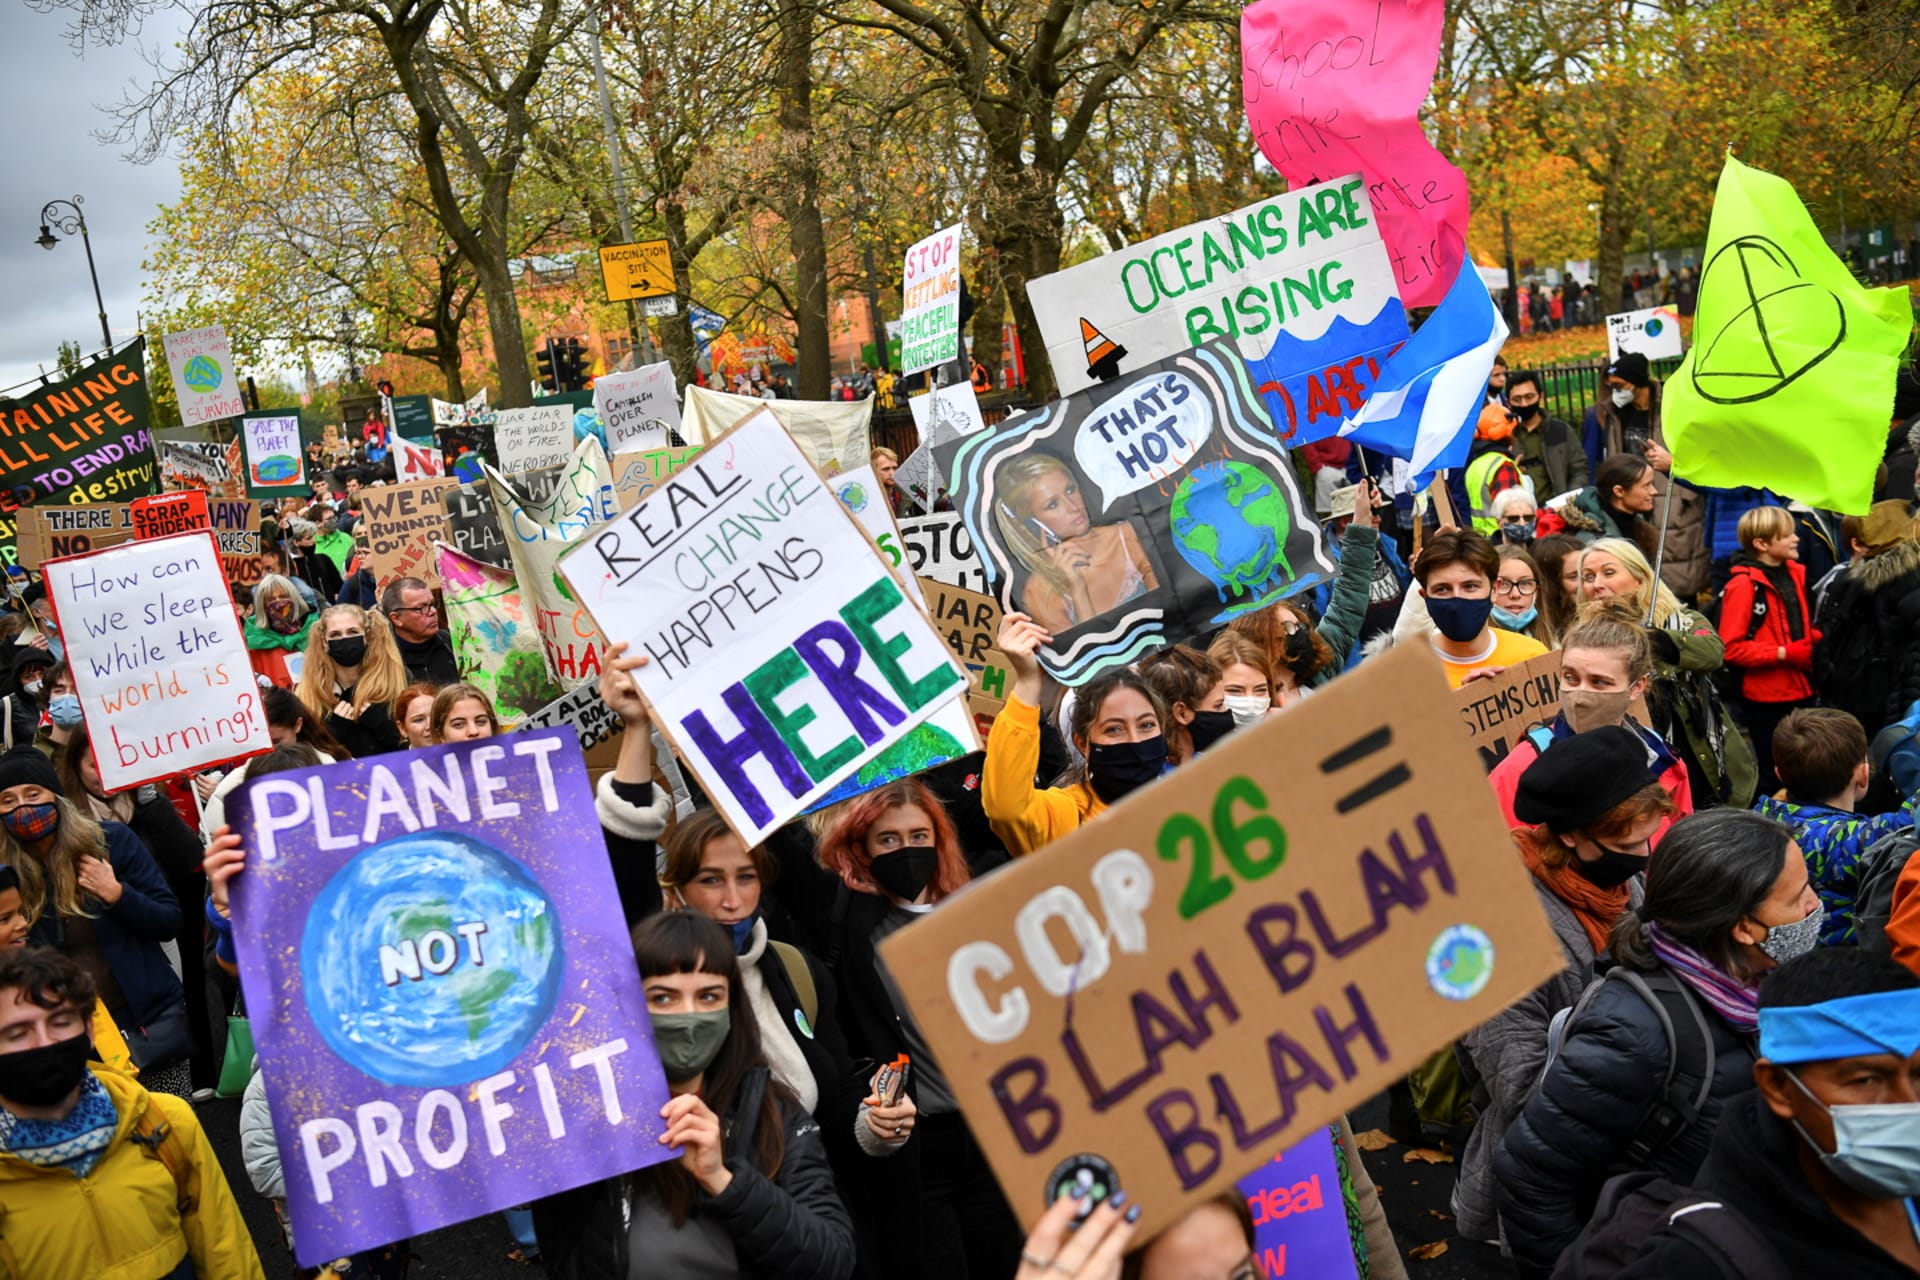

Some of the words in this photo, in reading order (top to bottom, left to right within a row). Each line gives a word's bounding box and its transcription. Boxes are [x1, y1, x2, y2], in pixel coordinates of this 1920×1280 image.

[603, 245, 667, 262] VACCINATION
[628, 262, 649, 274] SITE
[907, 235, 953, 279] STOP
[1121, 205, 1287, 313] OCEANS
[1298, 179, 1368, 247] ARE
[904, 267, 957, 312] KETTLING
[1185, 260, 1354, 347] RISING
[903, 302, 957, 345] PEACEFUL
[902, 332, 957, 373] PROTESTERS
[504, 427, 522, 438] THE
[532, 409, 561, 422] LIAR
[609, 406, 645, 428] OVER
[1090, 374, 1191, 444] THAT'S
[0, 440, 50, 475] LL
[48, 401, 134, 452] LIFE
[507, 438, 523, 451] ON
[1114, 415, 1187, 479] HOT
[33, 468, 74, 493] TO
[70, 443, 125, 478] END
[45, 509, 112, 530] THERE
[135, 502, 190, 524] SCRAP
[138, 514, 205, 539] TRIDENT
[362, 490, 418, 520] WE
[421, 484, 457, 506] AR
[595, 463, 742, 578] REAL
[51, 535, 91, 558] NO
[675, 464, 821, 592] CHANGE
[71, 568, 139, 602] How
[152, 557, 200, 579] can
[144, 592, 214, 625] sleep
[643, 536, 823, 680] HAPPENS
[930, 593, 994, 631] IAR
[90, 636, 165, 678] while
[177, 627, 223, 655] the
[101, 670, 188, 715] world
[203, 663, 230, 687] is
[679, 575, 960, 830] HERE
[111, 693, 259, 767] burning?
[250, 736, 562, 861] PLANET
[947, 774, 1288, 1043] COP26
[378, 921, 488, 987] NOT
[990, 949, 1241, 1155] BLAH
[1245, 812, 1456, 993] BLAH
[1147, 983, 1390, 1191] BLAH
[300, 1037, 628, 1204] PROFIT
